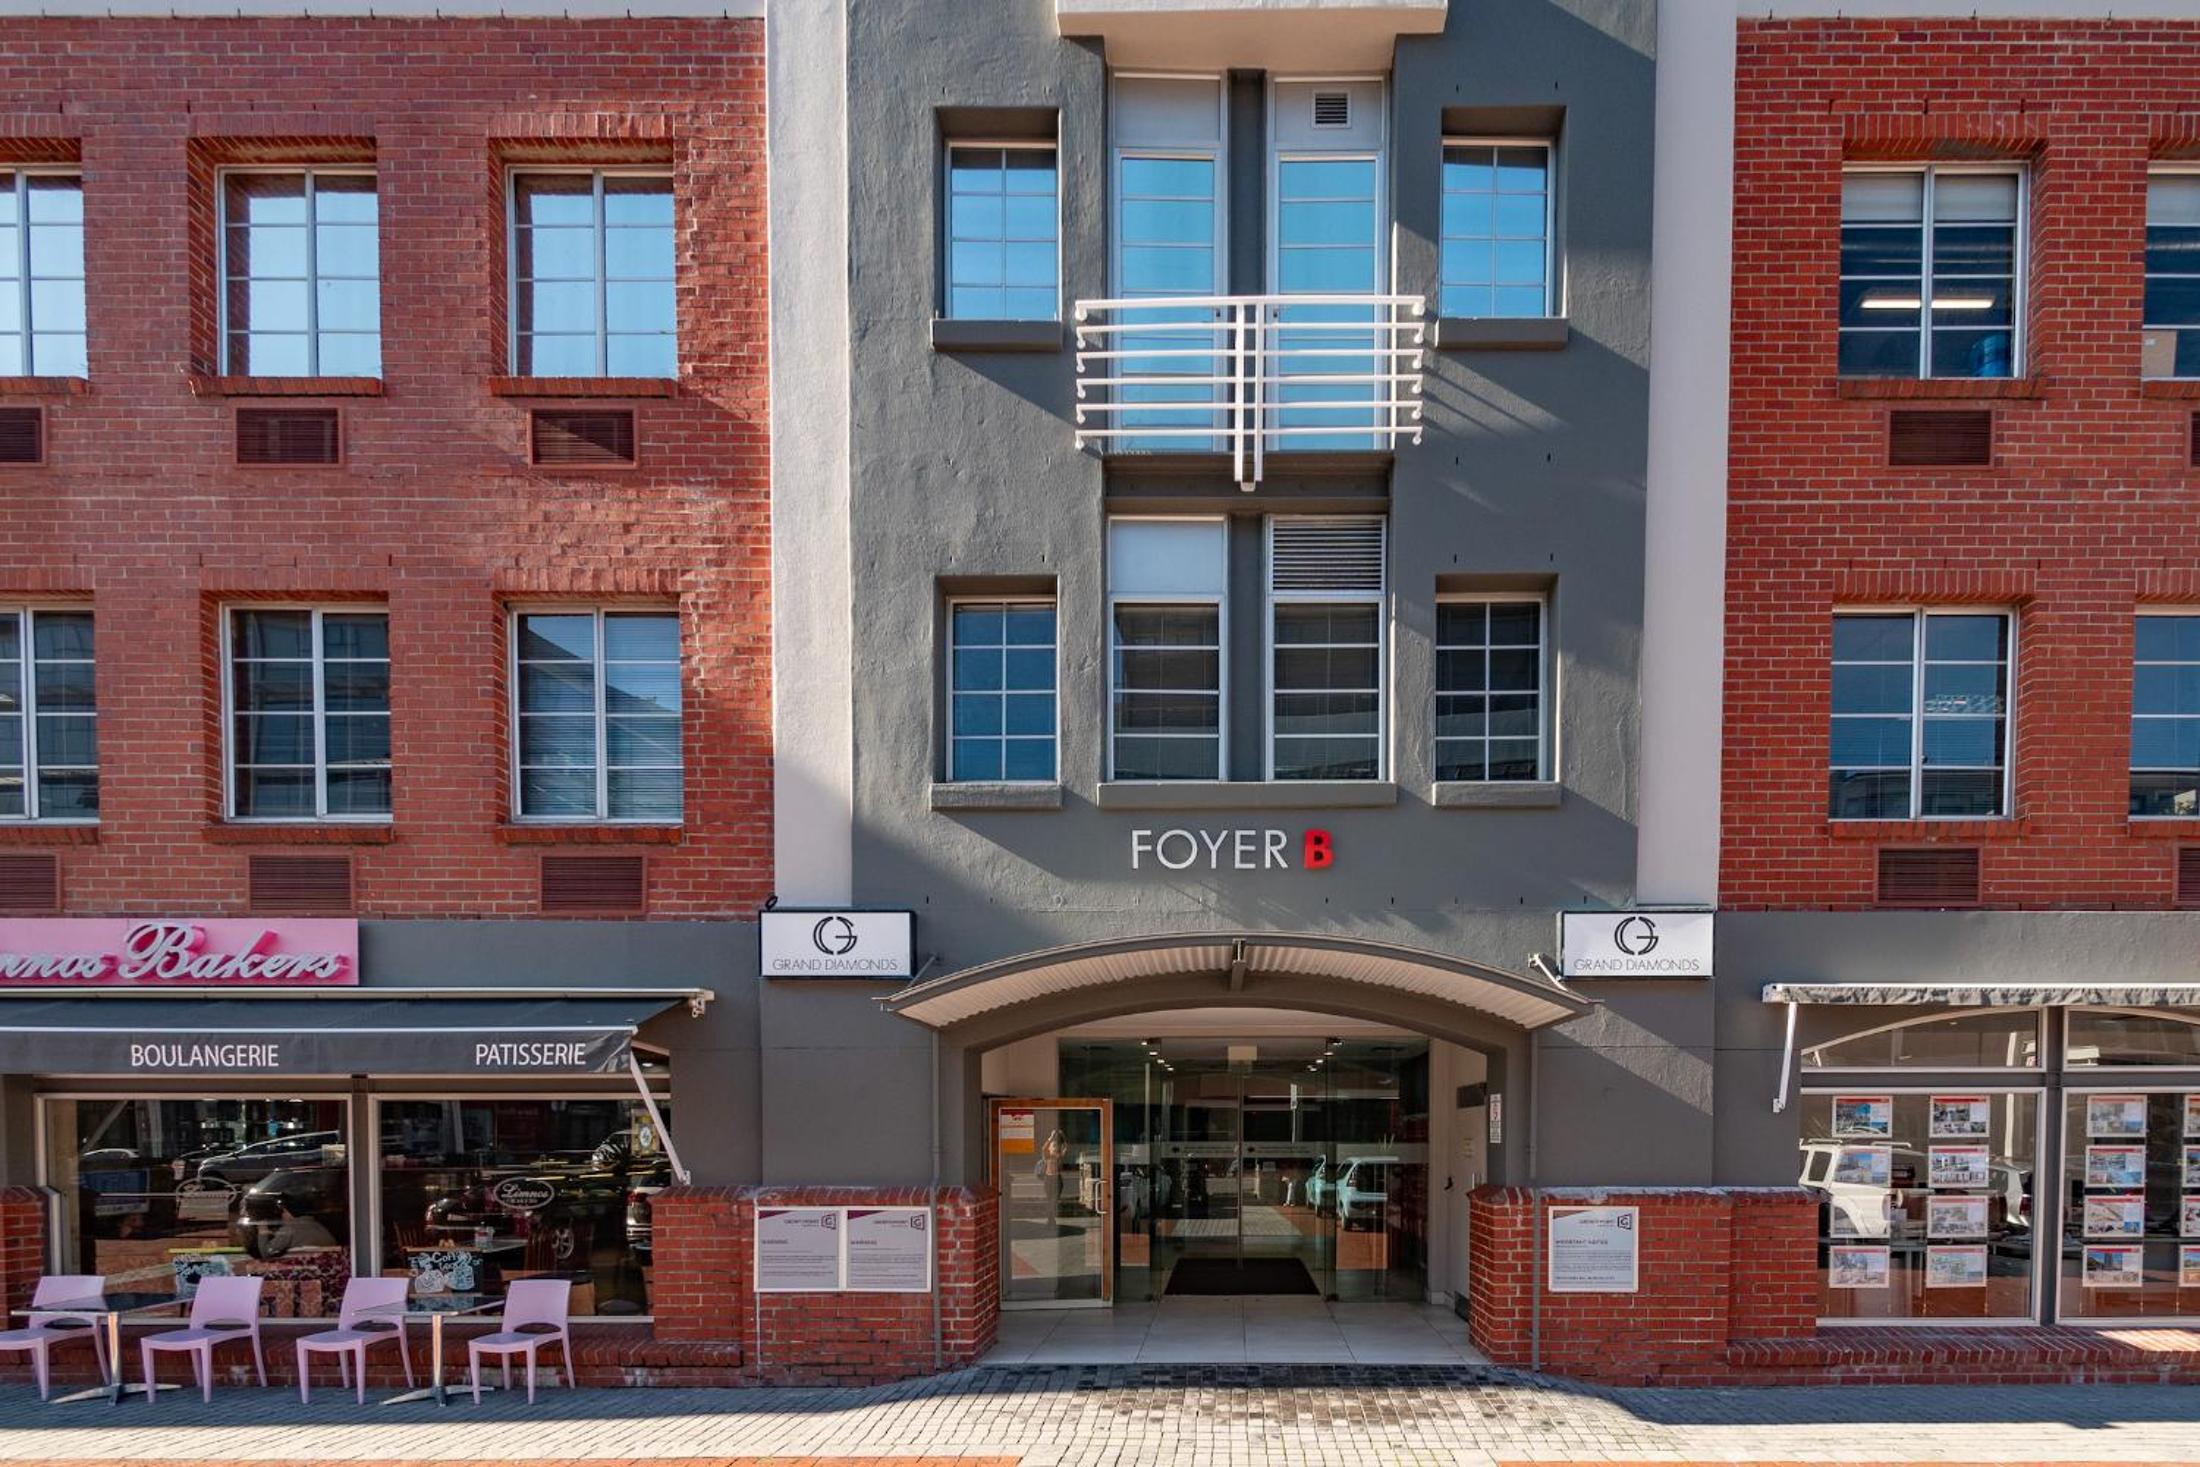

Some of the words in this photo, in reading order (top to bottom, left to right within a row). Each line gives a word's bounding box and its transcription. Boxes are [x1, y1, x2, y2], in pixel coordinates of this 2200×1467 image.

[1131, 829, 1289, 870] FOYER
[1303, 828, 1335, 870] B
[119, 922, 345, 978] Bakers
[772, 958, 822, 971] GRAND
[824, 958, 898, 971] DIAMONDS
[1573, 958, 1623, 971] GRAND
[1625, 958, 1700, 971] DIAMONDS
[130, 1044, 280, 1068] BOULANGERIE
[475, 1042, 587, 1066] PATISSERIE
